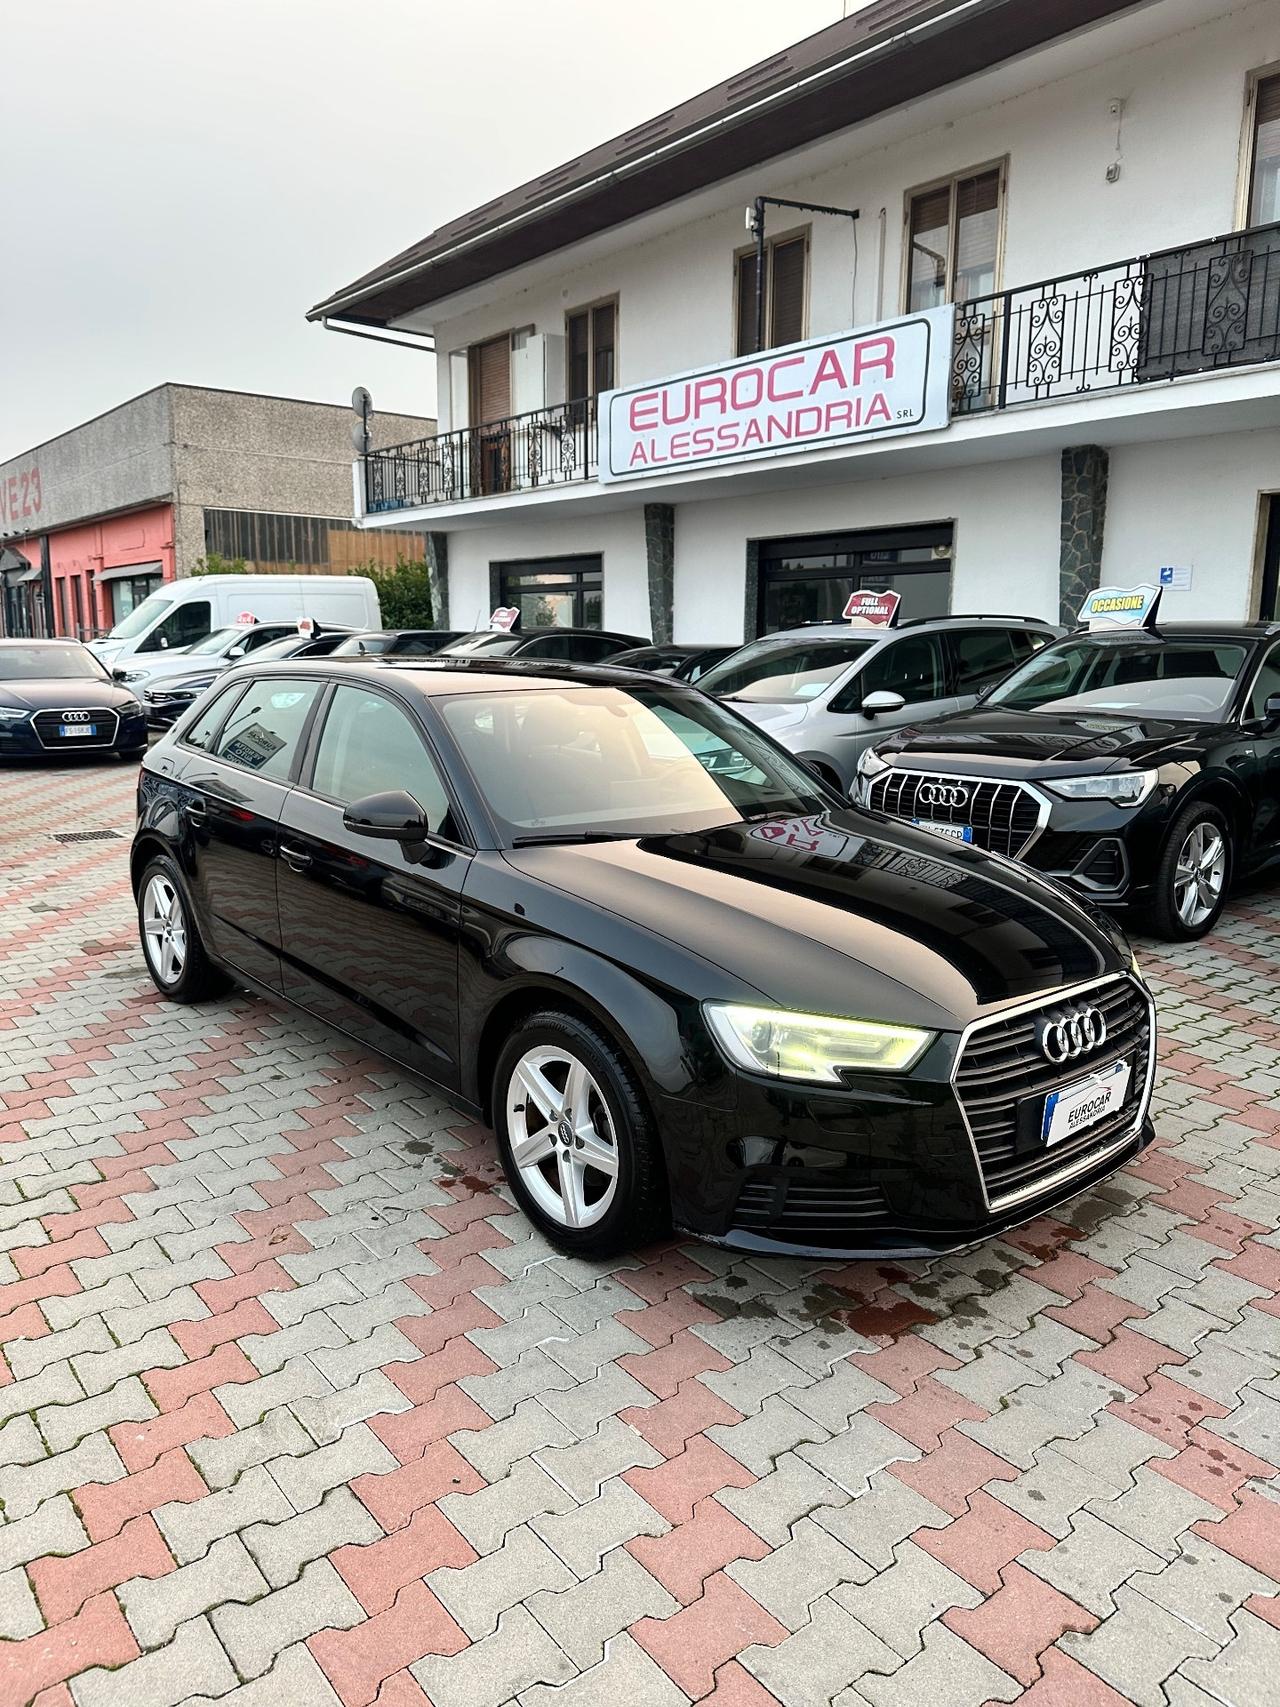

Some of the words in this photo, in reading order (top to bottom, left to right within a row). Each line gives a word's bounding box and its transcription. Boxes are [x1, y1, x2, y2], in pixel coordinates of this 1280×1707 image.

[629, 336, 895, 432] EUROCAR
[629, 392, 892, 467] ALESSANDRIA
[896, 408, 914, 419] SRL
[851, 606, 889, 615] OPTIONAL
[861, 597, 879, 606] FULL
[1091, 595, 1144, 613] OCCASIONE
[1067, 1091, 1112, 1124] EUROCAR
